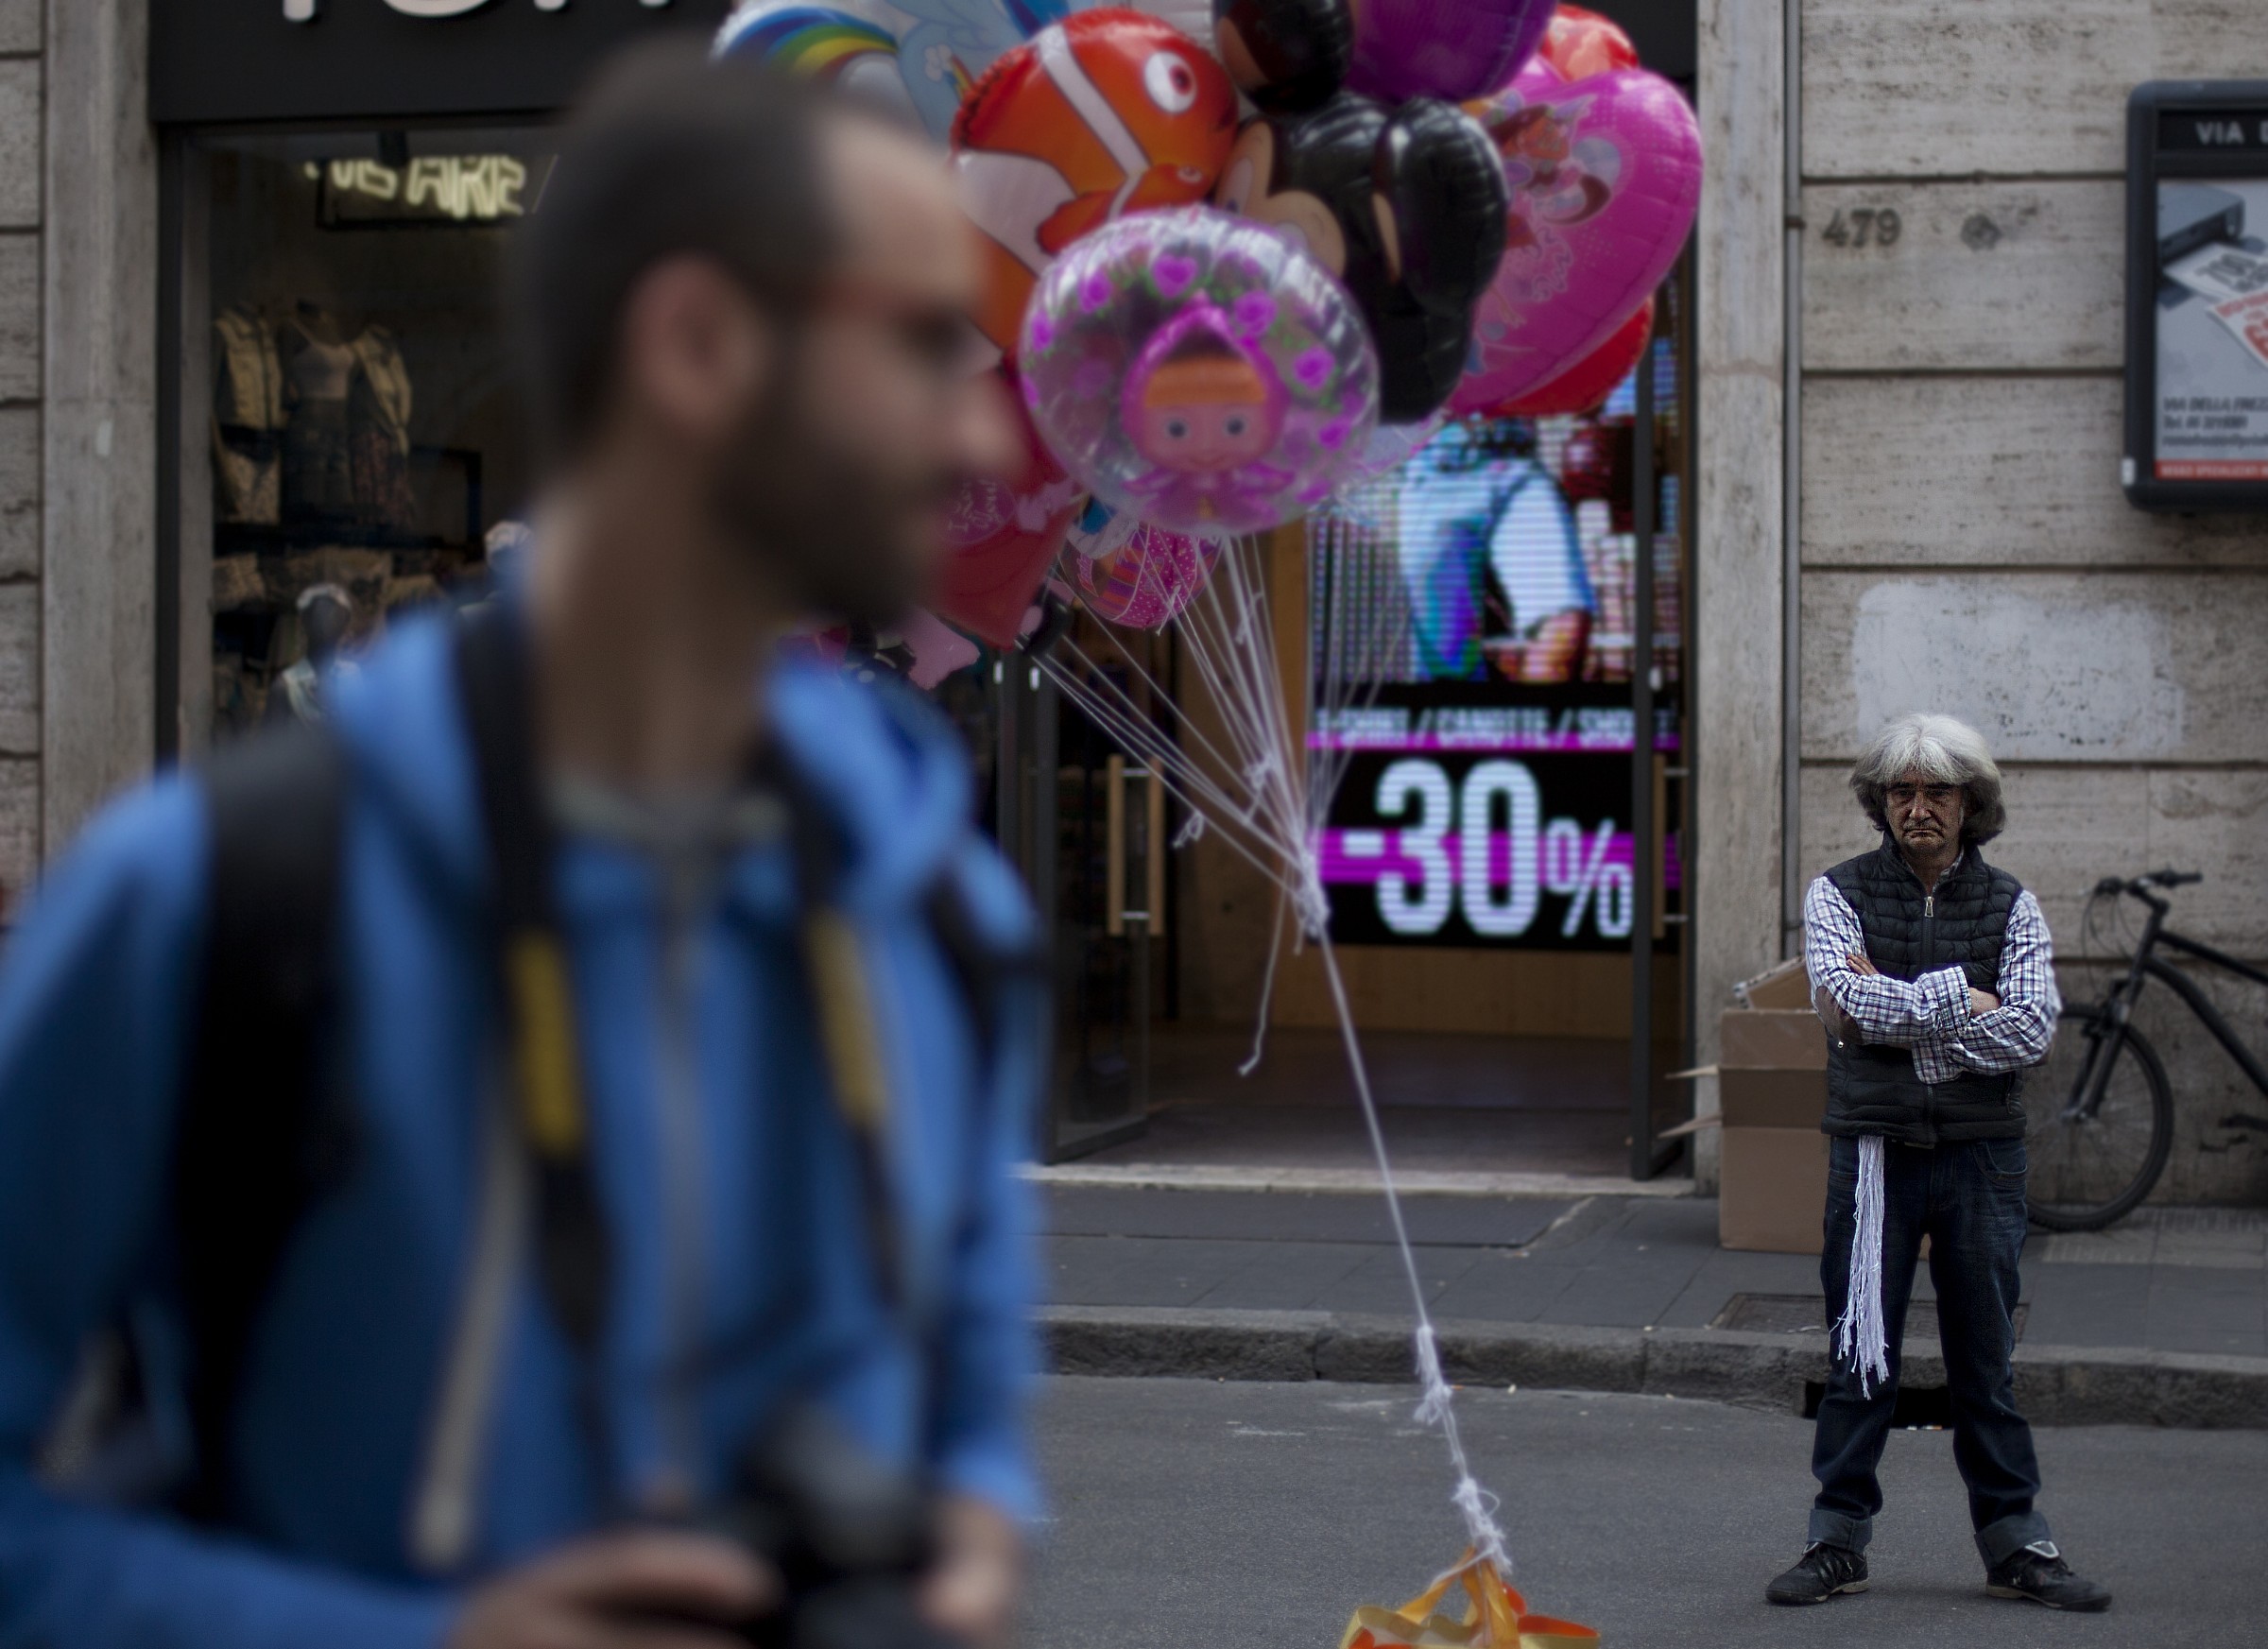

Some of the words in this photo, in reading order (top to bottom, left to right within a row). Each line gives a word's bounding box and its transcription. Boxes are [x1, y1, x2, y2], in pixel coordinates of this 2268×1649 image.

[2194, 121, 2245, 145] VIA
[1820, 208, 1902, 249] 479
[1435, 708, 1552, 749] CANOTTE
[1342, 757, 1633, 937] -30%
